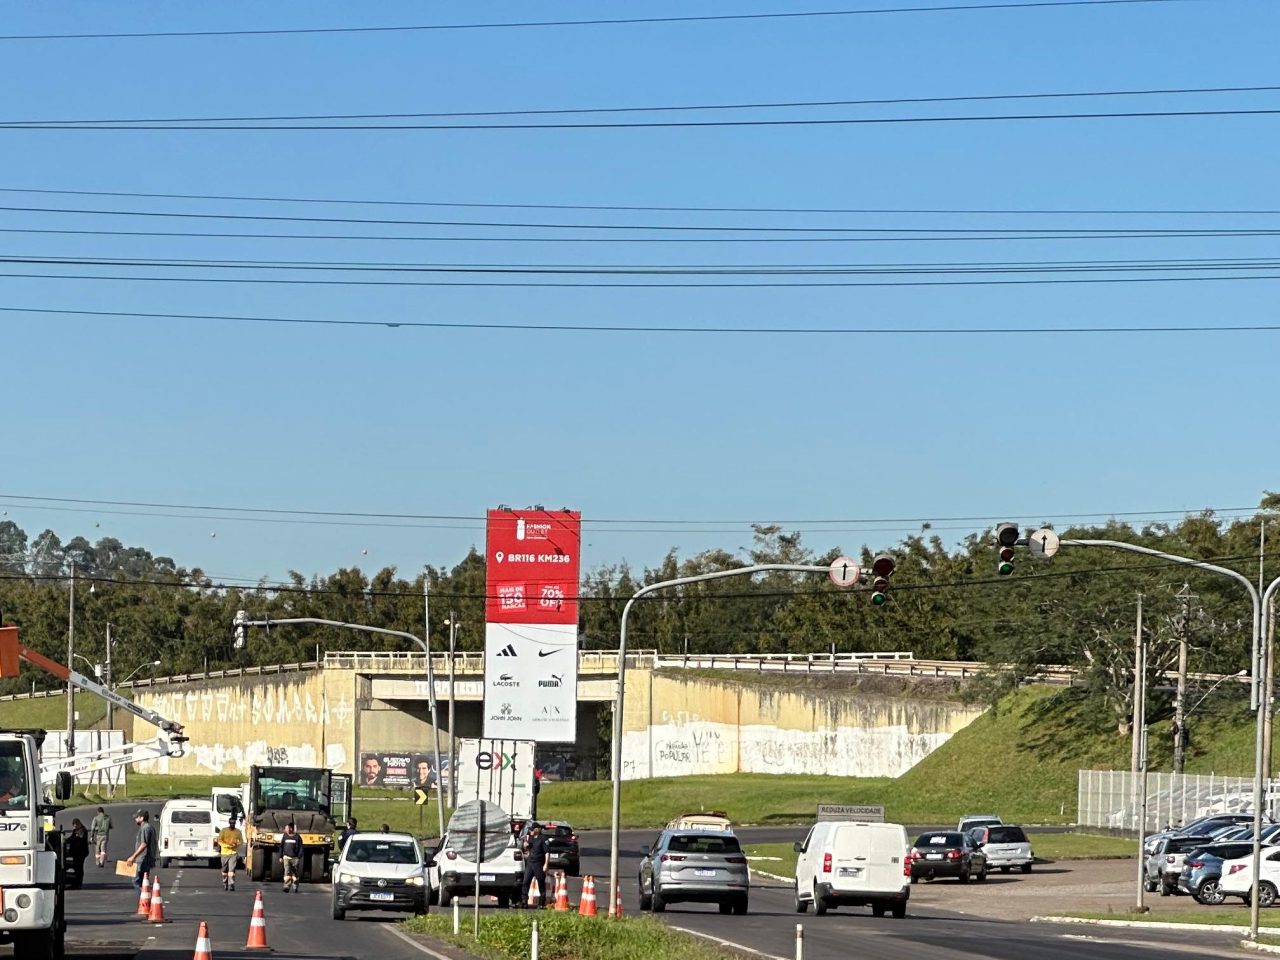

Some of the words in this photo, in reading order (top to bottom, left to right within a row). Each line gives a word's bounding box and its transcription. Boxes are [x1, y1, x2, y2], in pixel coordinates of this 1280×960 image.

[508, 554, 535, 562] BR116
[538, 554, 570, 562] KM236
[541, 588, 564, 599] 70%
[846, 807, 881, 815] VELOCIDADE
